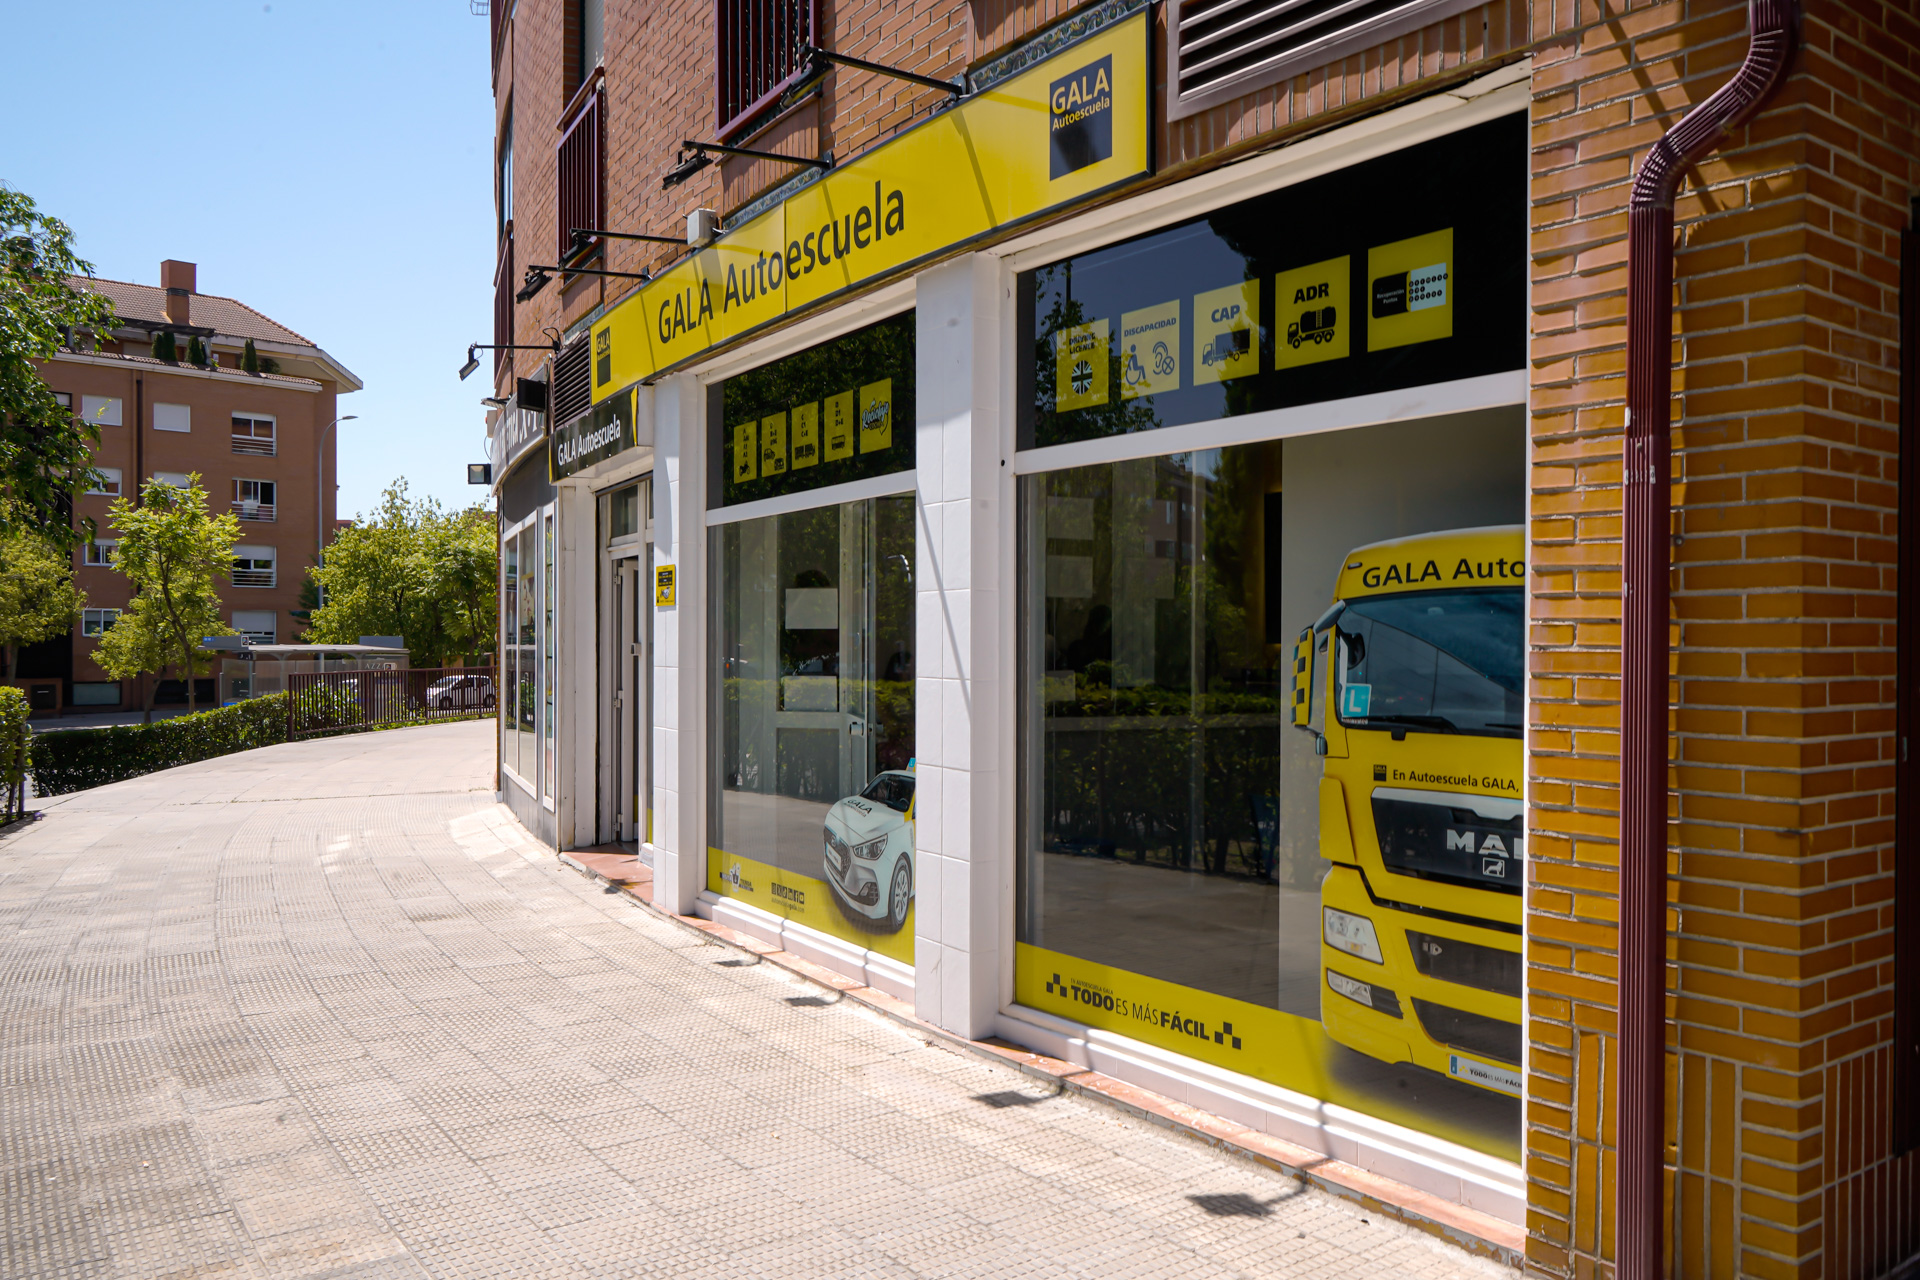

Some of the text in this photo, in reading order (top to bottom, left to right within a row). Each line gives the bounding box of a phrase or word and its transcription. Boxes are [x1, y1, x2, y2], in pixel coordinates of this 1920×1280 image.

[1052, 67, 1109, 114] GALA
[1052, 96, 1110, 131] Autoescuela
[658, 180, 904, 343] GALA Autoescuela
[1293, 282, 1329, 304] ADR
[1124, 317, 1177, 337] DISCAPACIDAD
[1211, 304, 1240, 323] CAP
[558, 414, 620, 466] GALA Autoescuela
[1362, 558, 1525, 588] GALA Auto
[1349, 690, 1361, 712] L
[1393, 769, 1519, 793] En Autoescuela GALA,
[848, 800, 872, 814] GALA
[1071, 985, 1210, 1041] TODO ES MÁS FÁCIL
